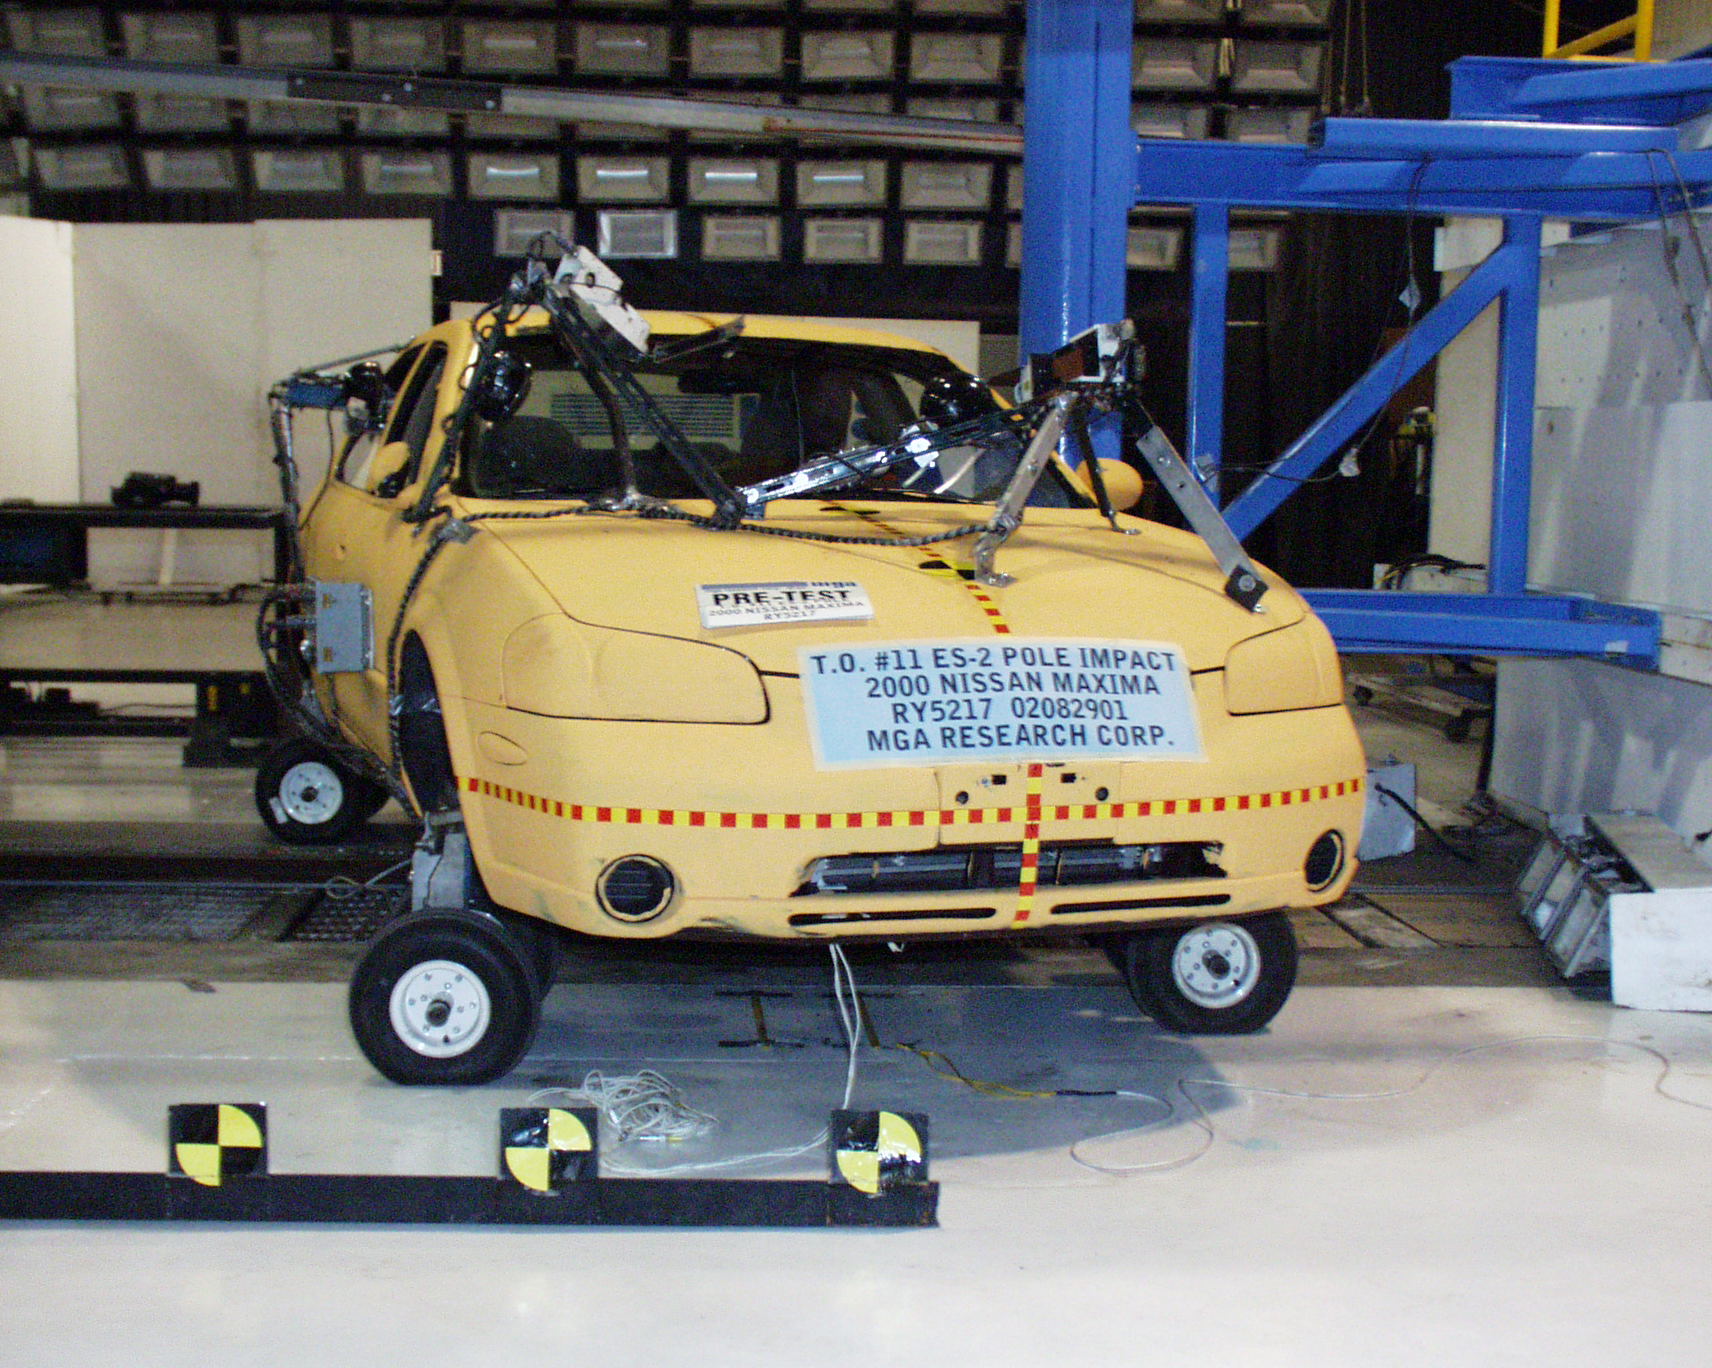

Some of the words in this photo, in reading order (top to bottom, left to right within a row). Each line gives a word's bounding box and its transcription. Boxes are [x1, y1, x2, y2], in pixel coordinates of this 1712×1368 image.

[709, 609, 742, 617] 2000
[745, 605, 799, 614] NISSAN
[805, 601, 864, 610] MAXIMA
[713, 590, 850, 606] PRE-TEST
[764, 611, 816, 620] RY5217
[811, 653, 865, 674] T.O.
[874, 649, 922, 671] #11
[933, 647, 993, 669] ES-2
[1003, 646, 1071, 667] POLE
[1079, 647, 1176, 672] IMPACT
[865, 675, 930, 698] 2000
[940, 672, 1043, 694] NISSAN
[1053, 672, 1161, 696] MAXIMA
[892, 698, 992, 724] RY5217
[1011, 697, 1128, 721] 02082901
[867, 729, 931, 751] MGA
[940, 724, 1087, 749] RESEARCH
[1099, 724, 1174, 746] CORP.
